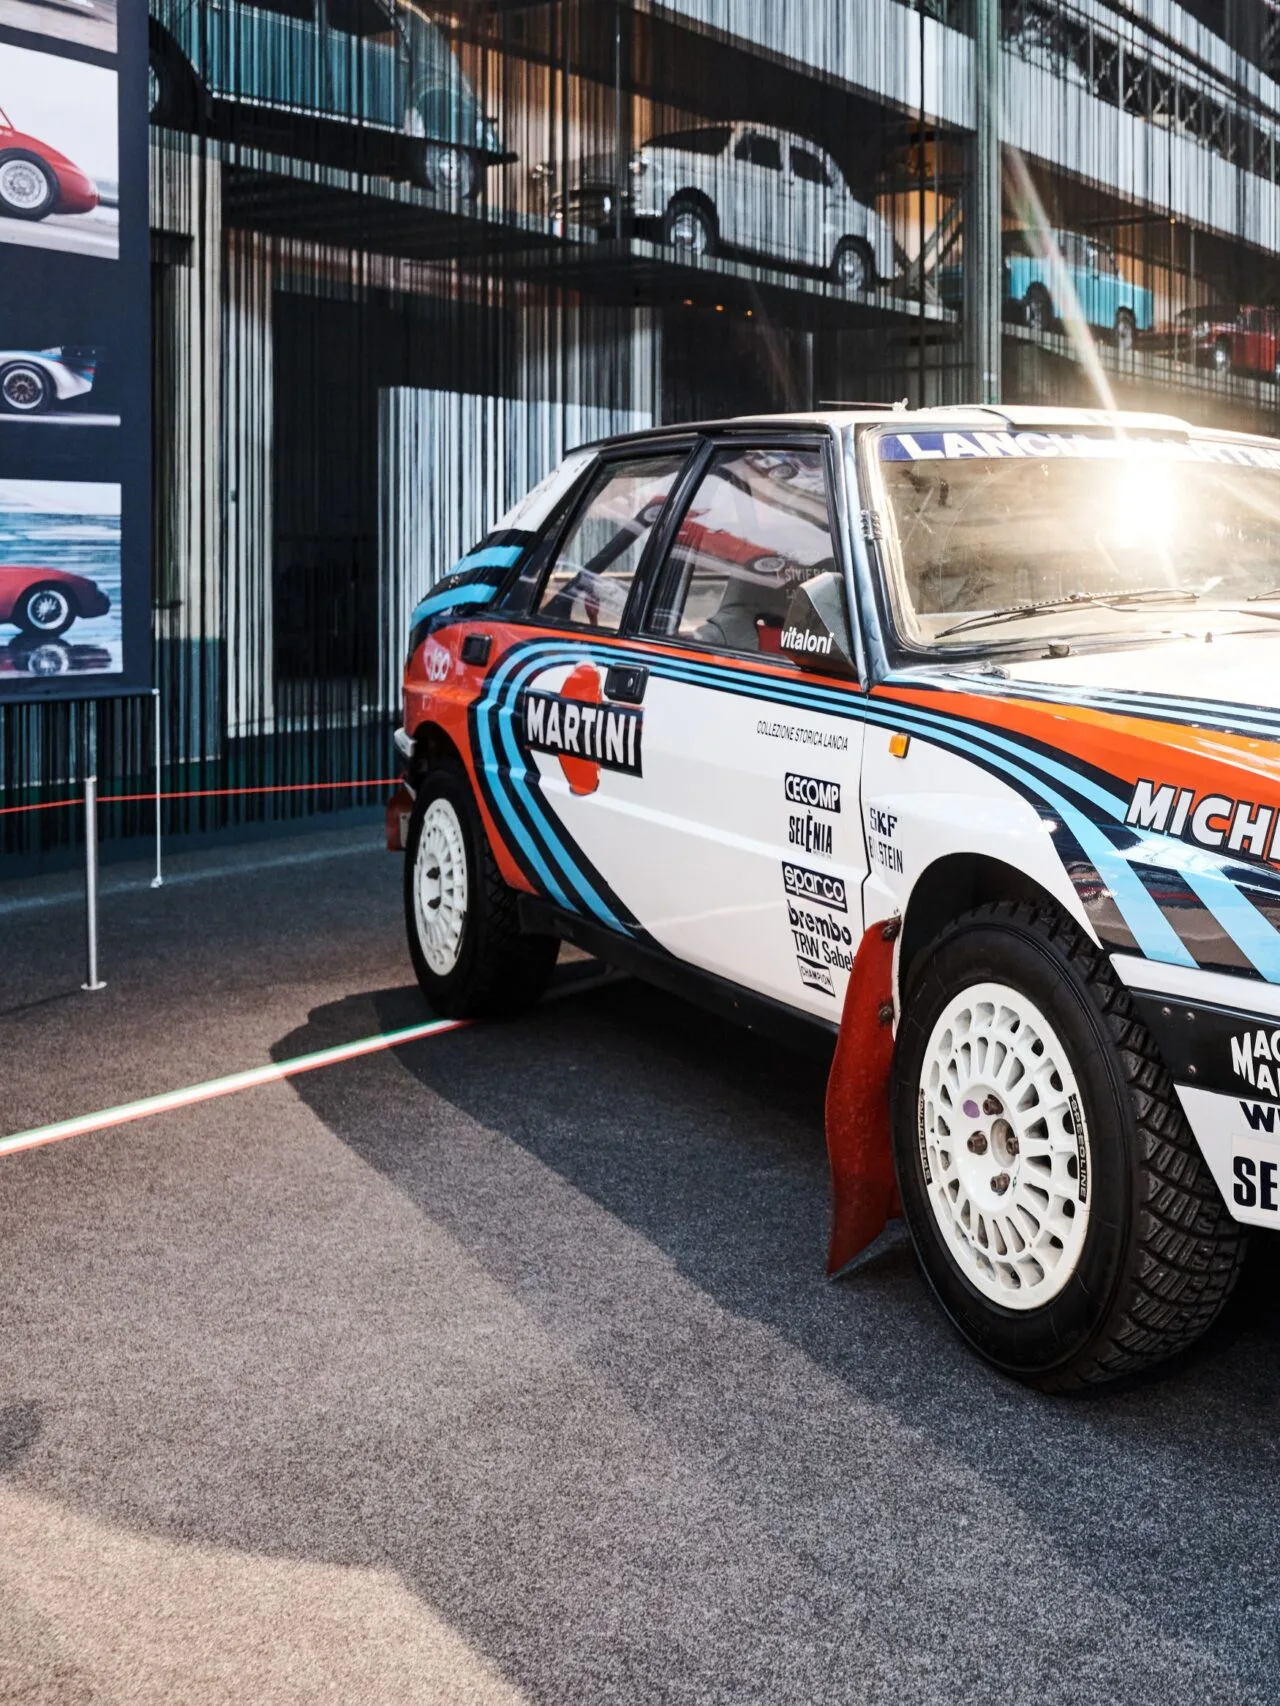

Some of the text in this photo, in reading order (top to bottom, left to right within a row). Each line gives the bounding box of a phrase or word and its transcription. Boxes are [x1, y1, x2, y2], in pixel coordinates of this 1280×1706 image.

[780, 626, 835, 654] vitaloni
[527, 697, 637, 767] MARTINI
[756, 720, 849, 751] COLLEZIONE STORICA LANCIA
[785, 775, 840, 811] CECOMP
[788, 809, 833, 854] SELÈNIA
[869, 807, 898, 838] SKF
[783, 865, 846, 902] sparco
[786, 898, 853, 947] brembo
[791, 929, 857, 973] TRW Sabel
[800, 965, 833, 986] CHAMPION
